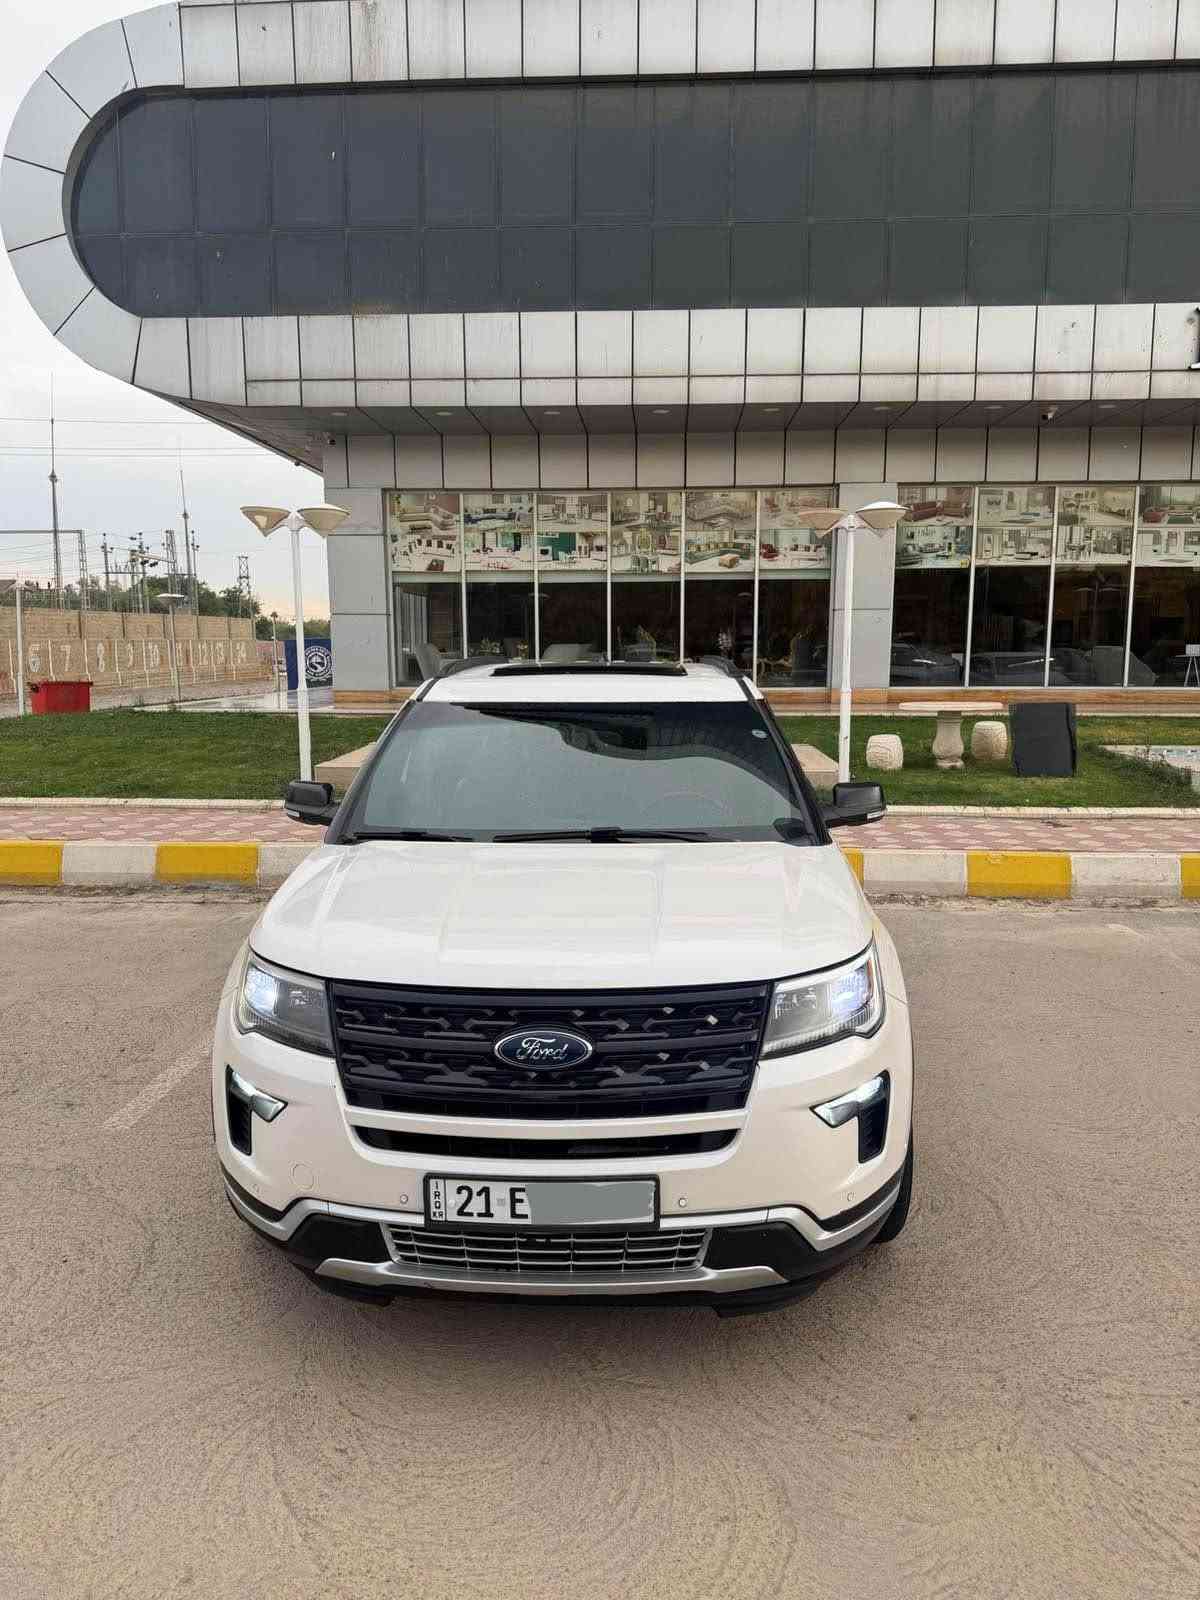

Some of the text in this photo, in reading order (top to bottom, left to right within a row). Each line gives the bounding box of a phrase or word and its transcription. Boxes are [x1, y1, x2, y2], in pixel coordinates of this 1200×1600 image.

[60, 644, 72, 672] 7
[96, 642, 105, 673] 8
[516, 1037, 569, 1060] Ford
[456, 1185, 530, 1219] 21 E
